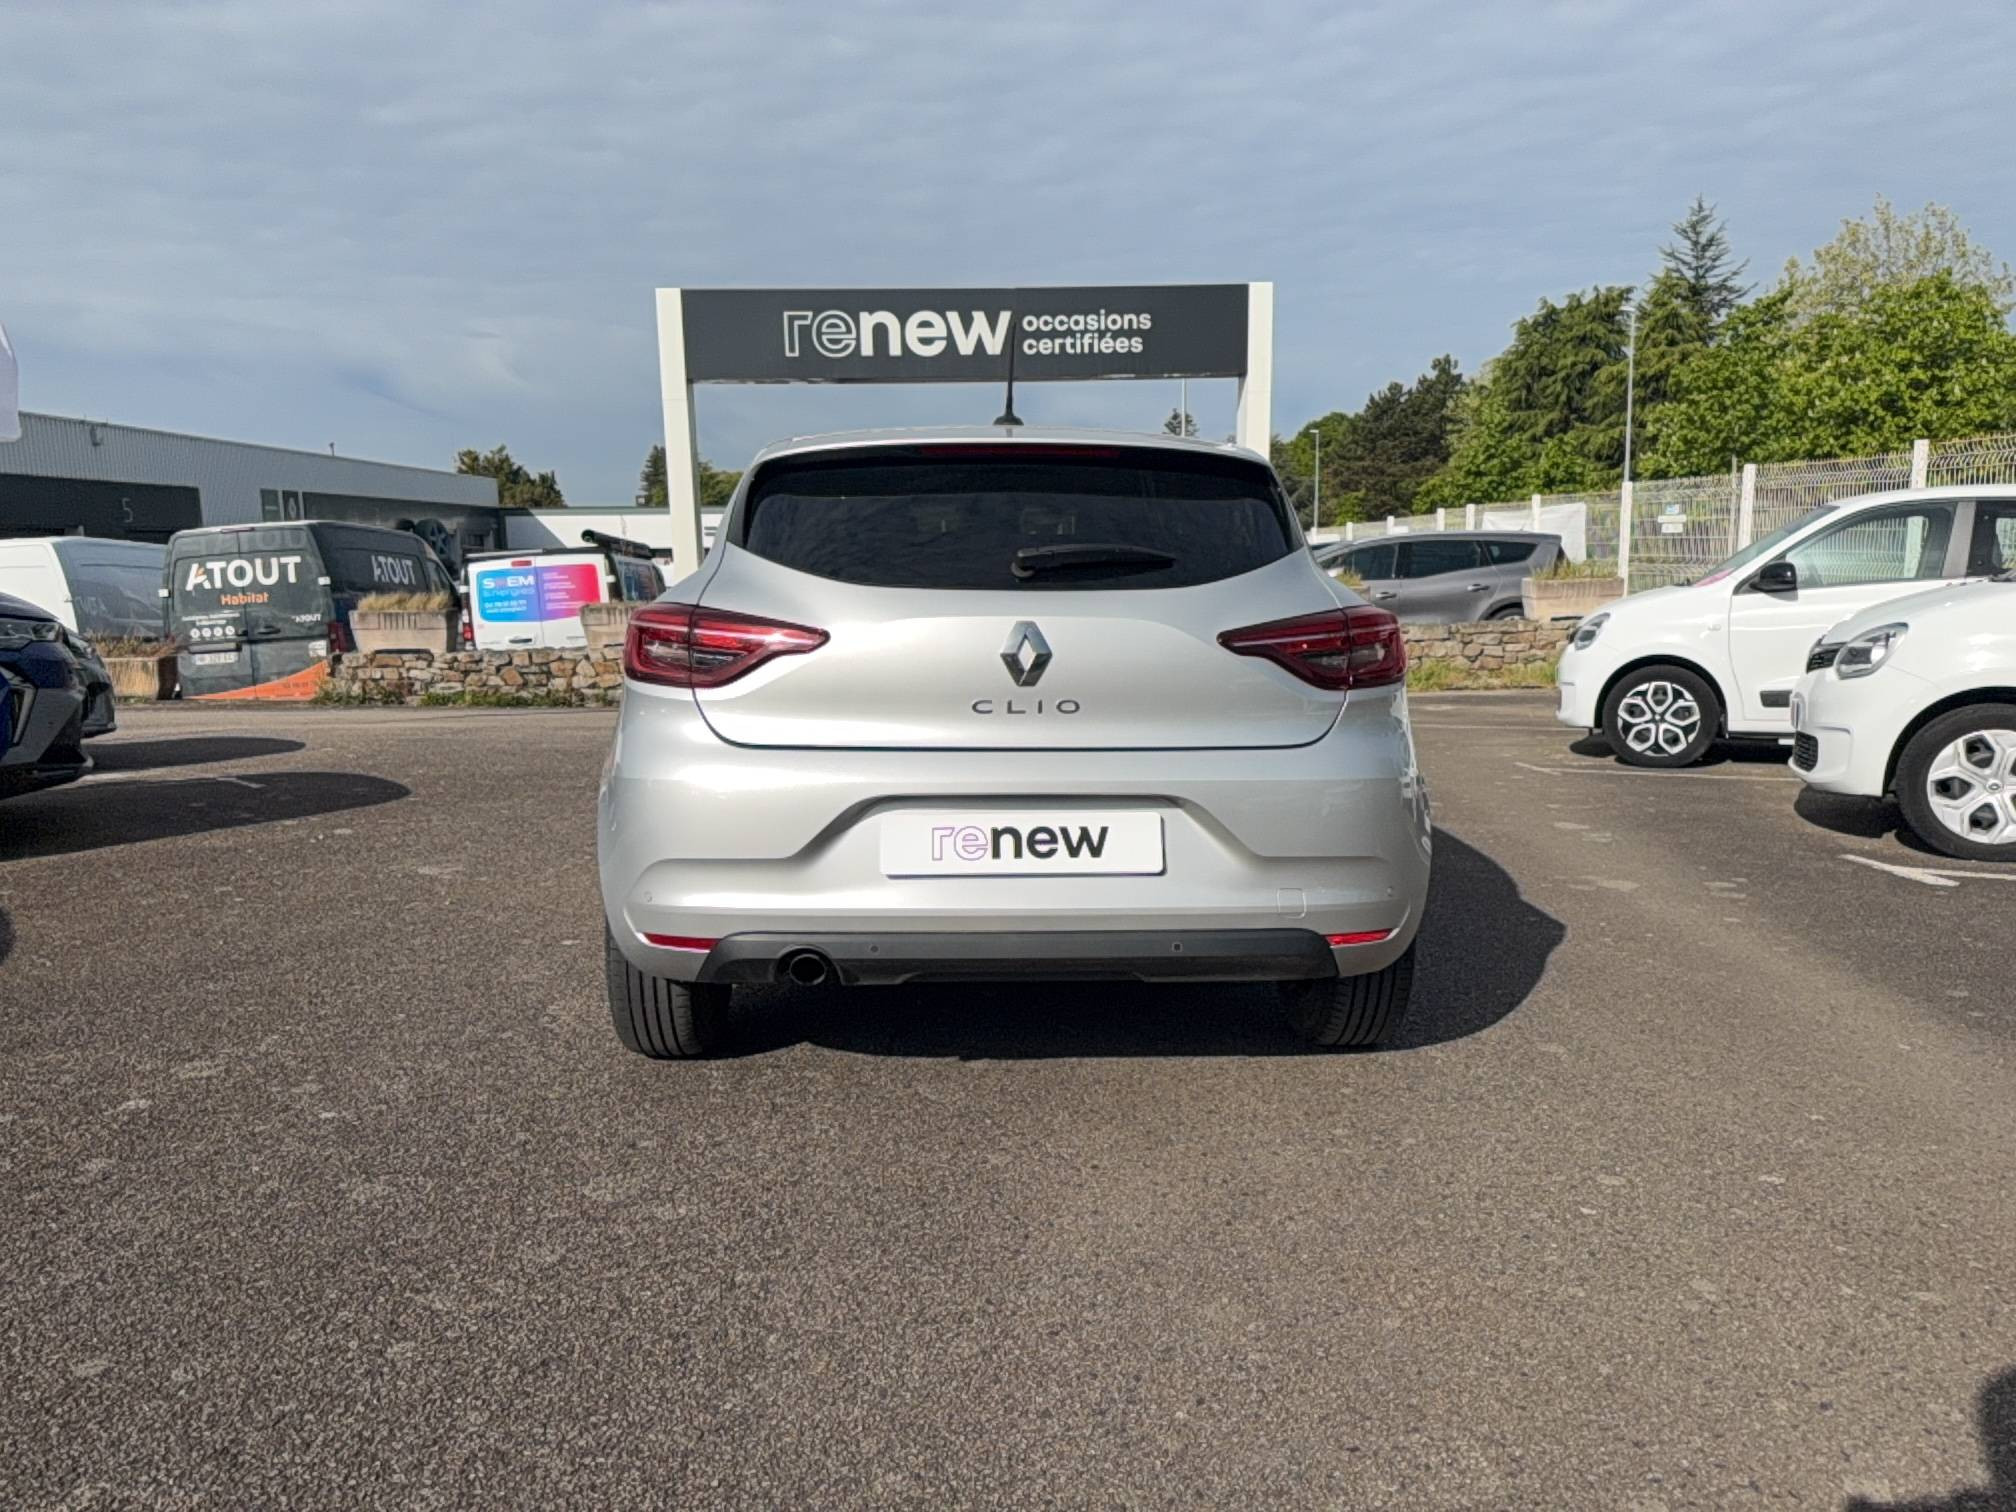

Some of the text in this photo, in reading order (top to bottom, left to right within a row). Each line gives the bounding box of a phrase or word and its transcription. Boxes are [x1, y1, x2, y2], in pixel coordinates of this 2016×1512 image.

[1022, 309, 1152, 331] occasions
[783, 310, 1012, 357] renew
[1022, 332, 1143, 355] certifiées
[122, 497, 133, 522] 5
[185, 556, 302, 591] ATOUT
[371, 554, 417, 585] ATOUT
[220, 592, 270, 606] Habitat
[971, 699, 1081, 714] CLIO
[931, 826, 1110, 861] renew
